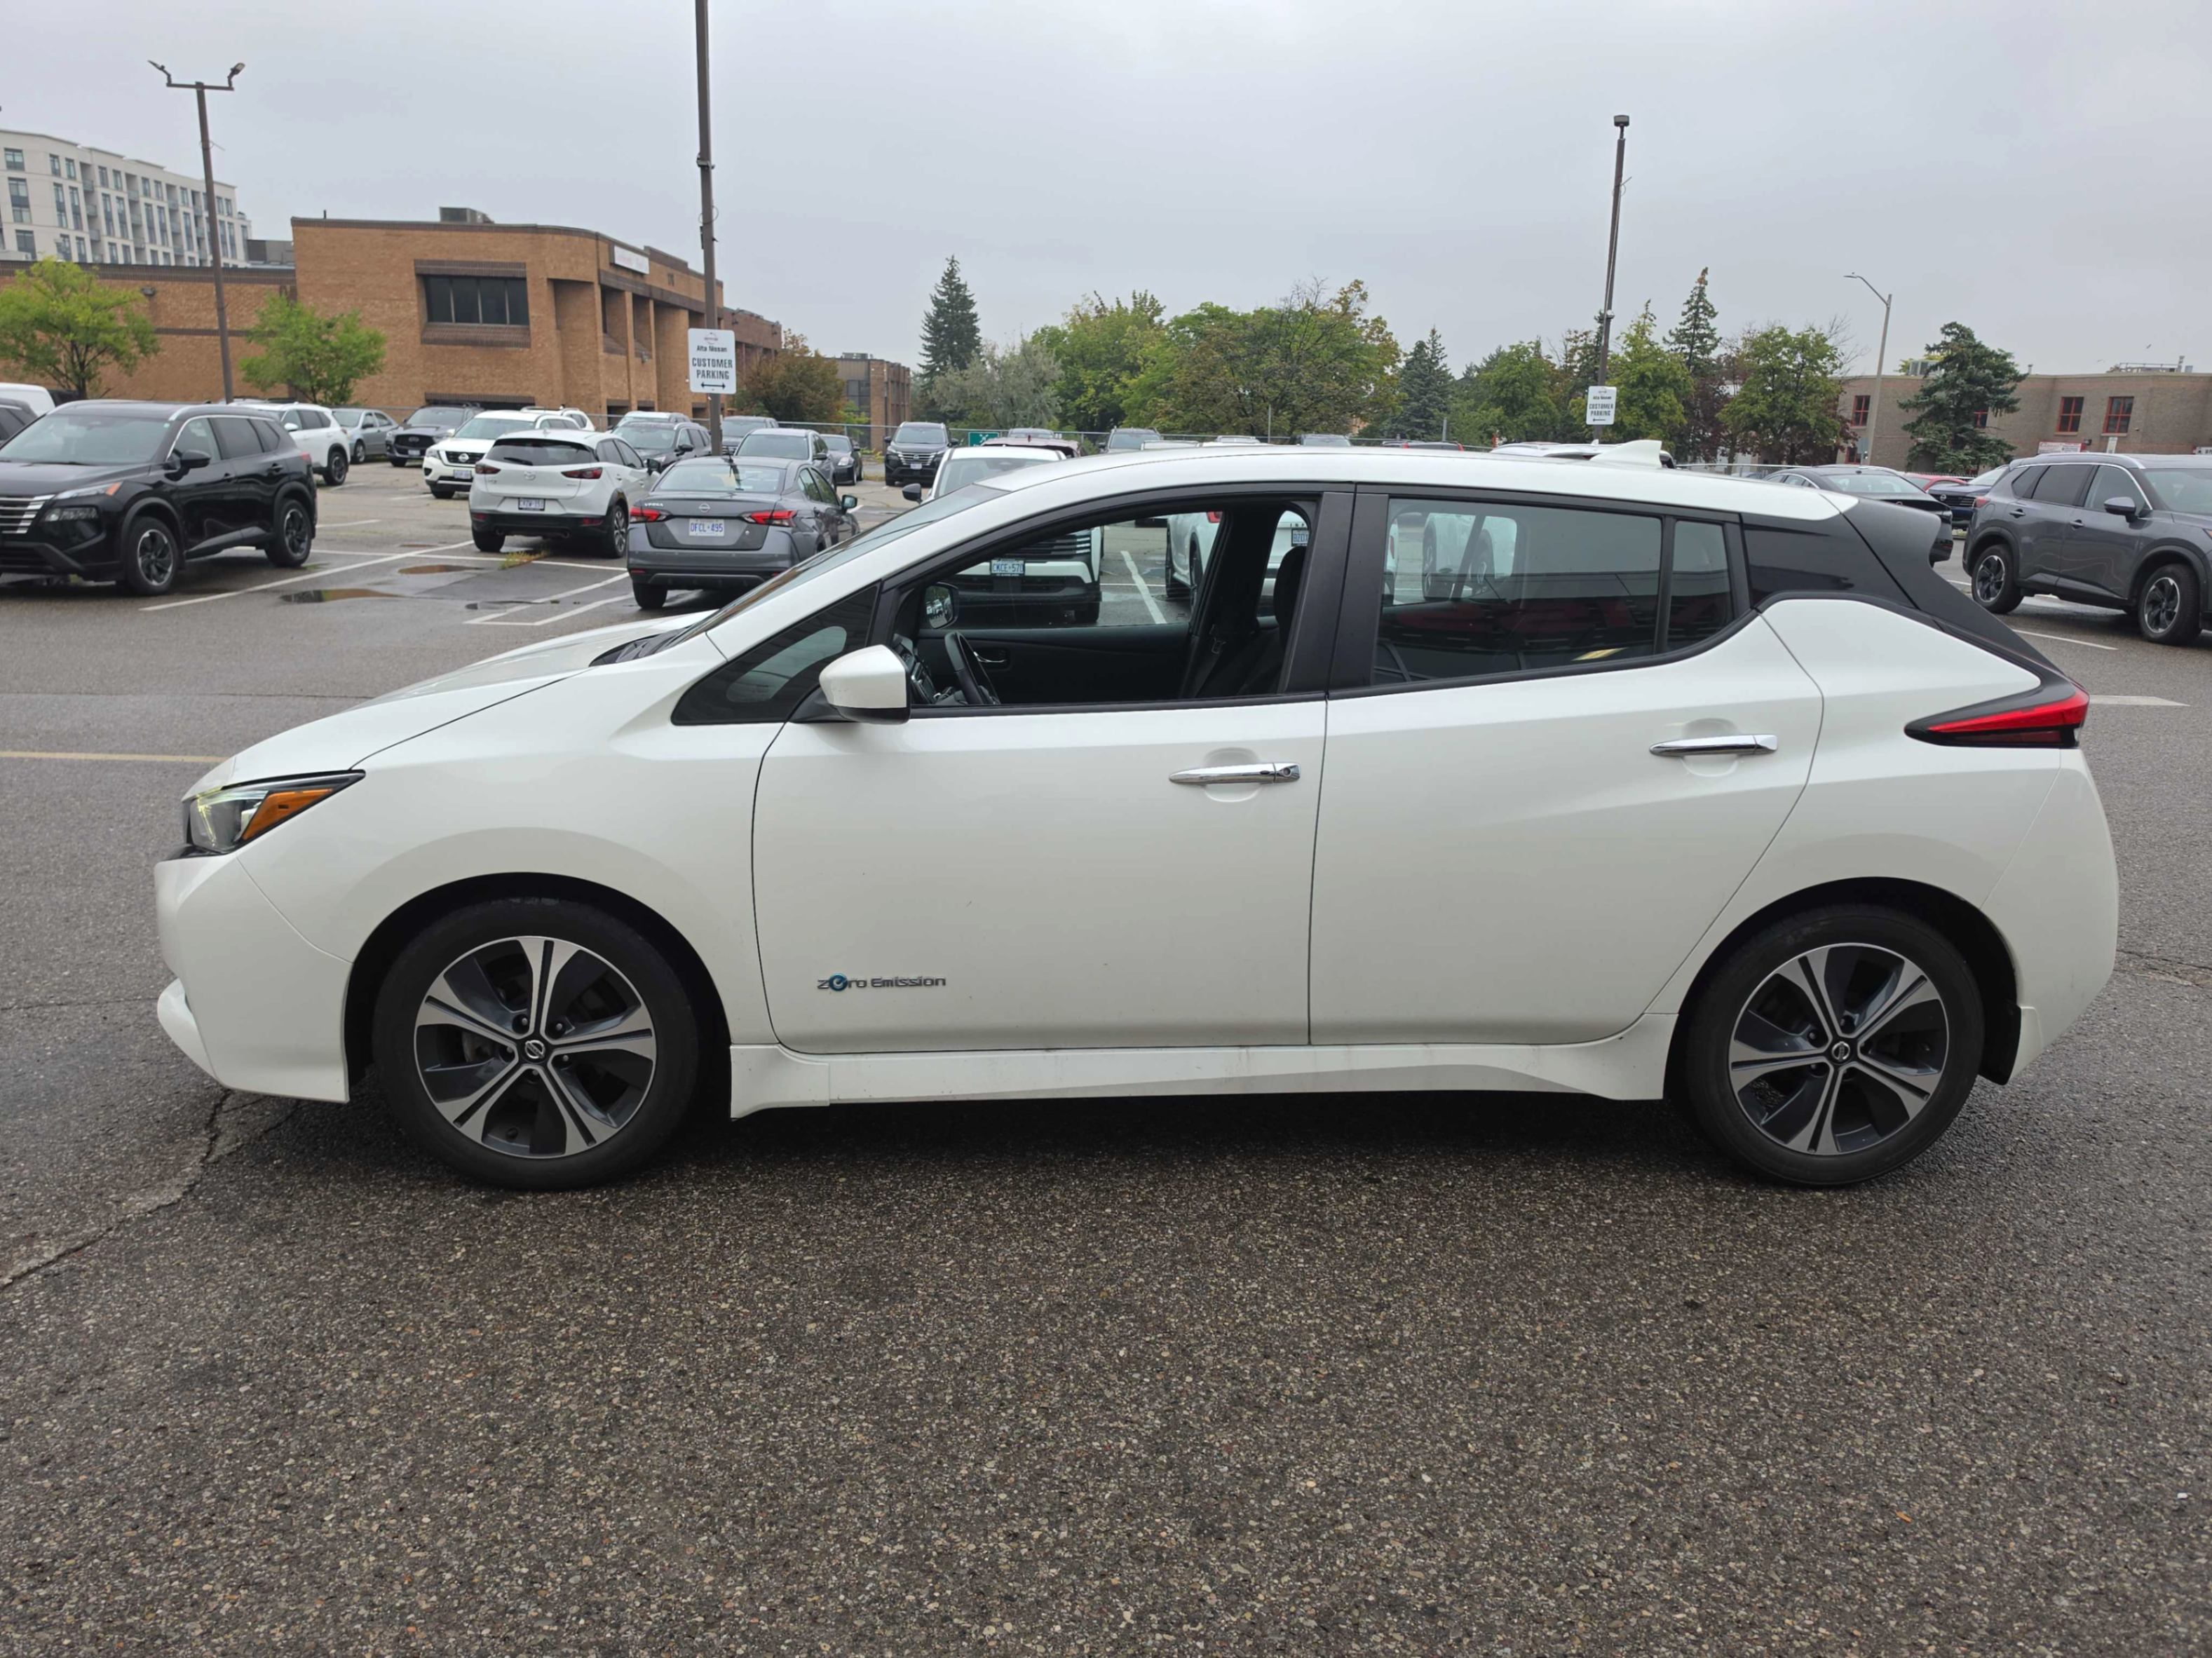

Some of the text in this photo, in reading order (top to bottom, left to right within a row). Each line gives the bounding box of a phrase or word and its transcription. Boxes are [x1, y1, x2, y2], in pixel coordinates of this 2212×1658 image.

[692, 358, 733, 368] CUSTOMER
[696, 369, 729, 379] PARKING
[871, 976, 946, 988] Emission
